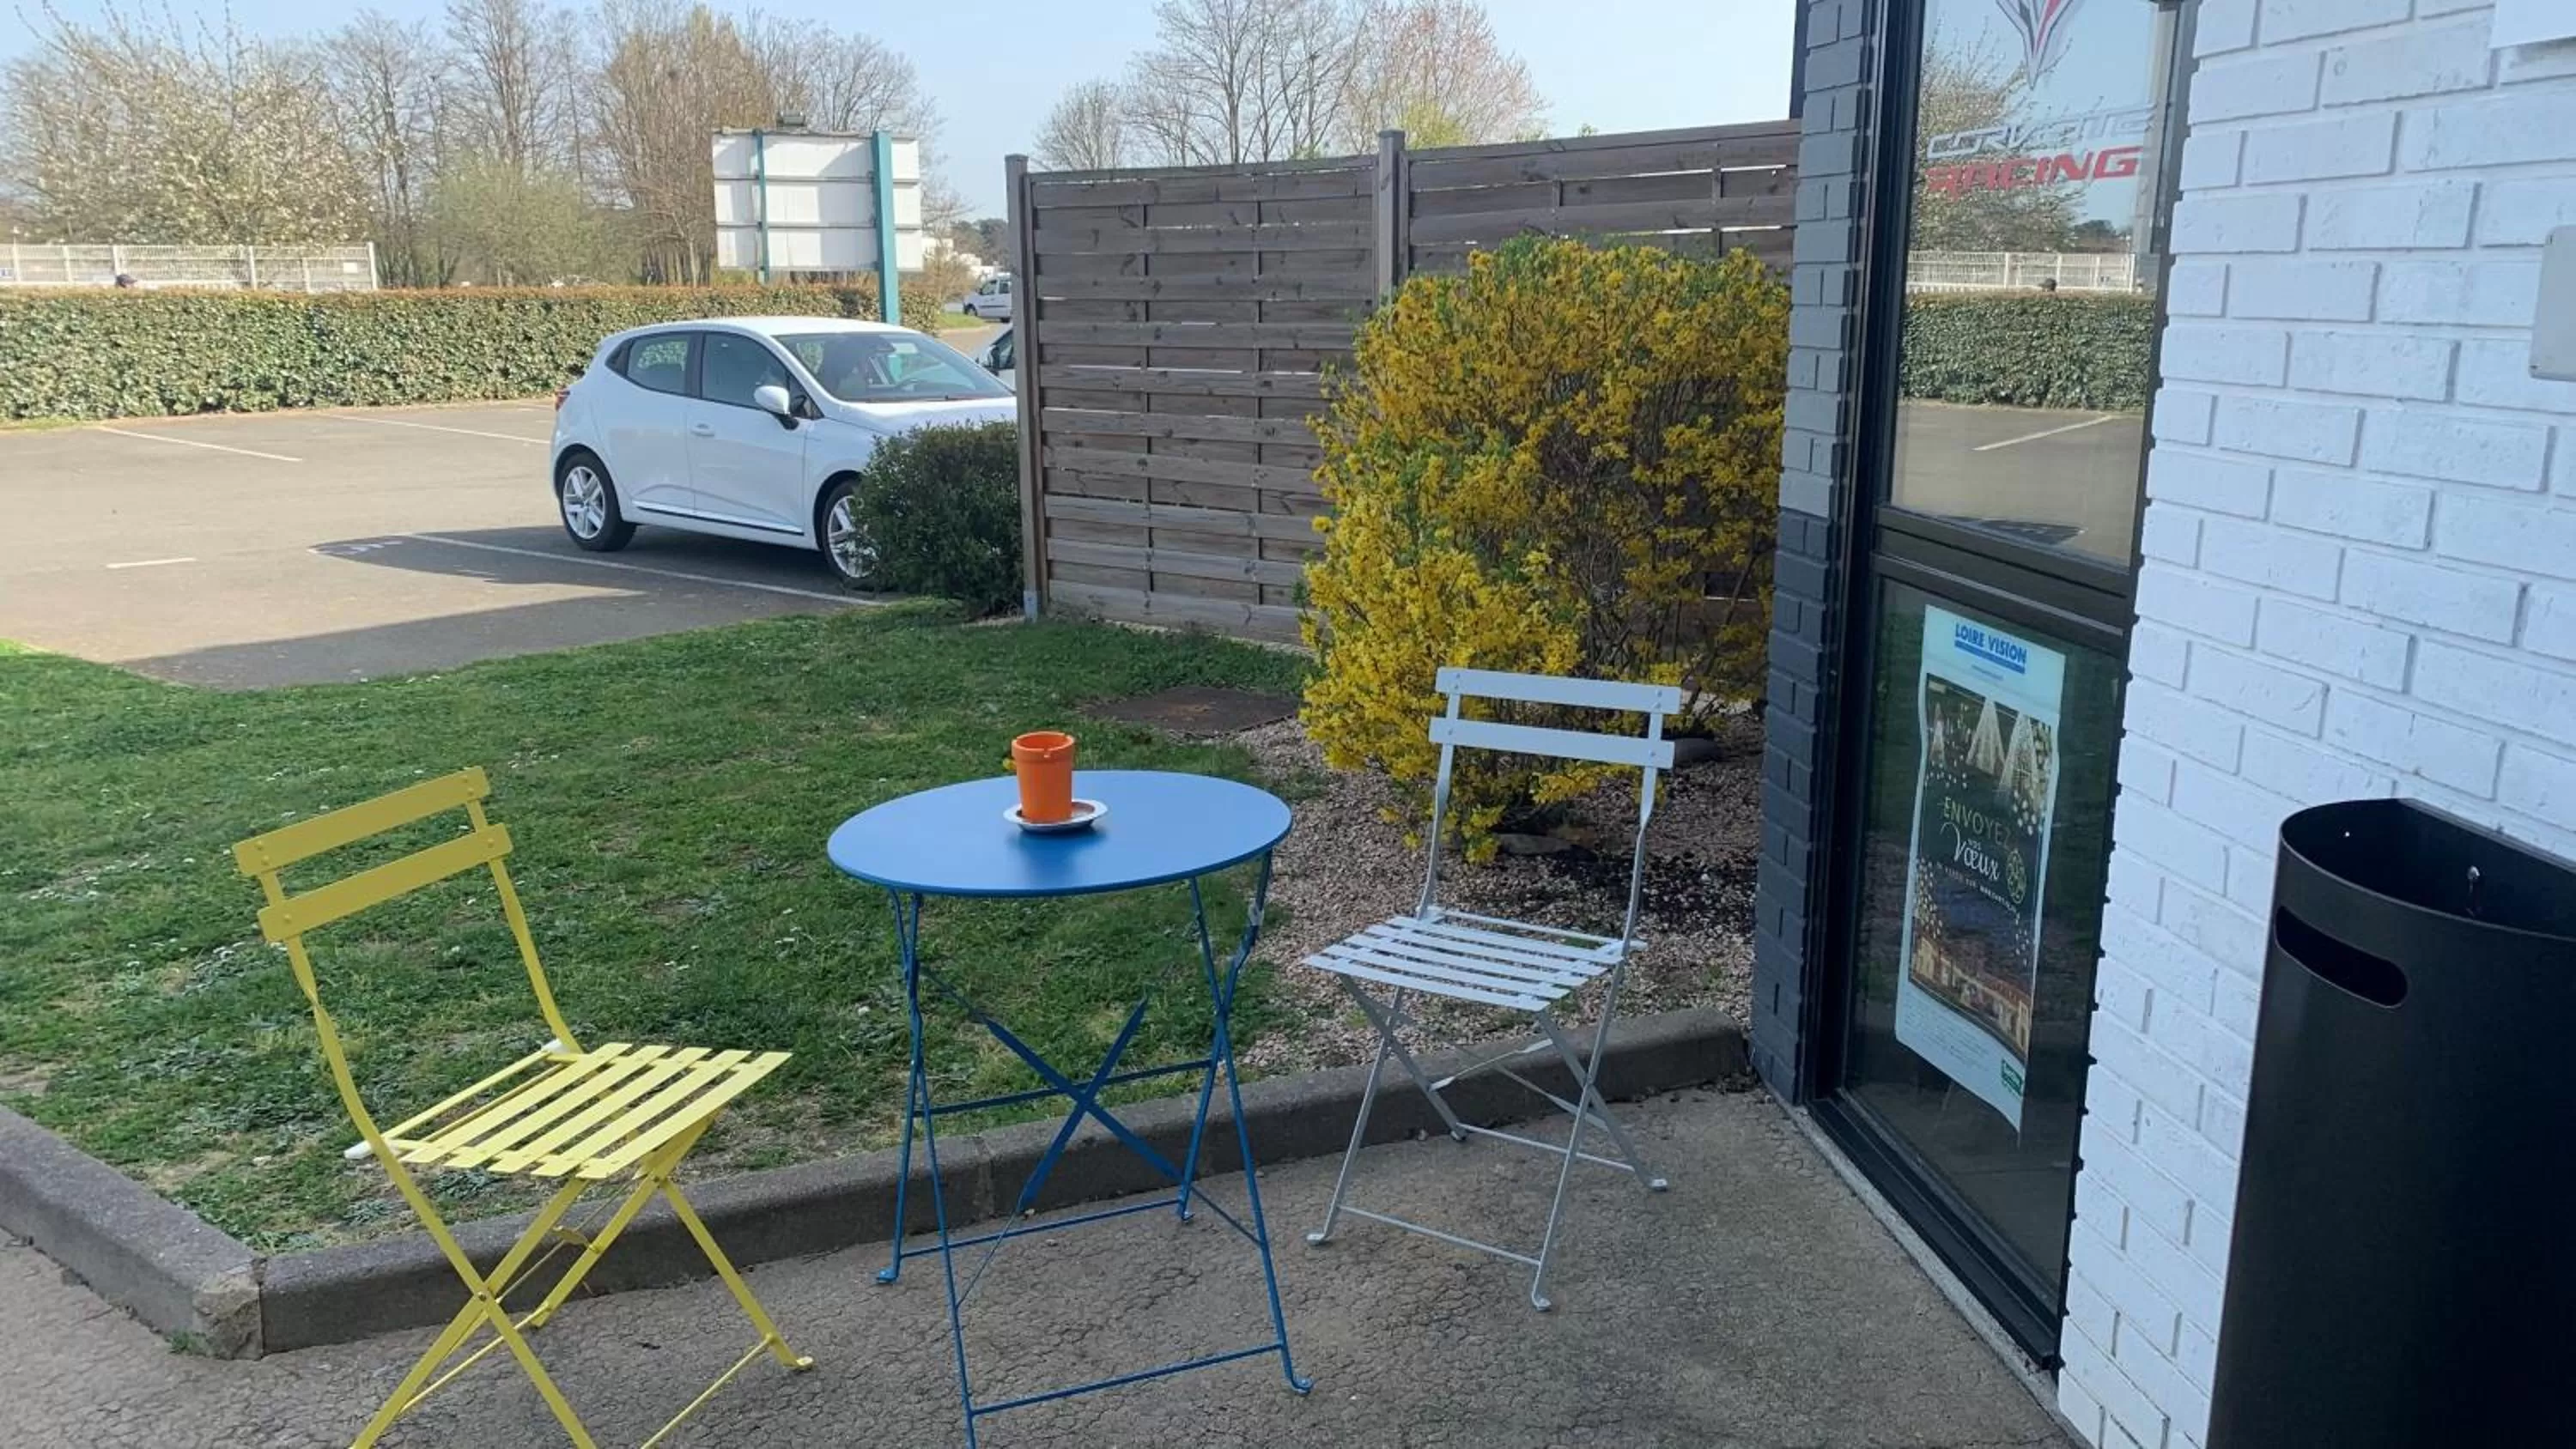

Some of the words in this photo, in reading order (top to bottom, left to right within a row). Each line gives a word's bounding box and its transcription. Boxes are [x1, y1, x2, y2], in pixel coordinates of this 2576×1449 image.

[1925, 146, 2144, 201] RACING
[1955, 623, 1985, 647] LOIRE
[1988, 635, 2027, 664] VISION
[1944, 796, 2011, 851] ENVOYEZ
